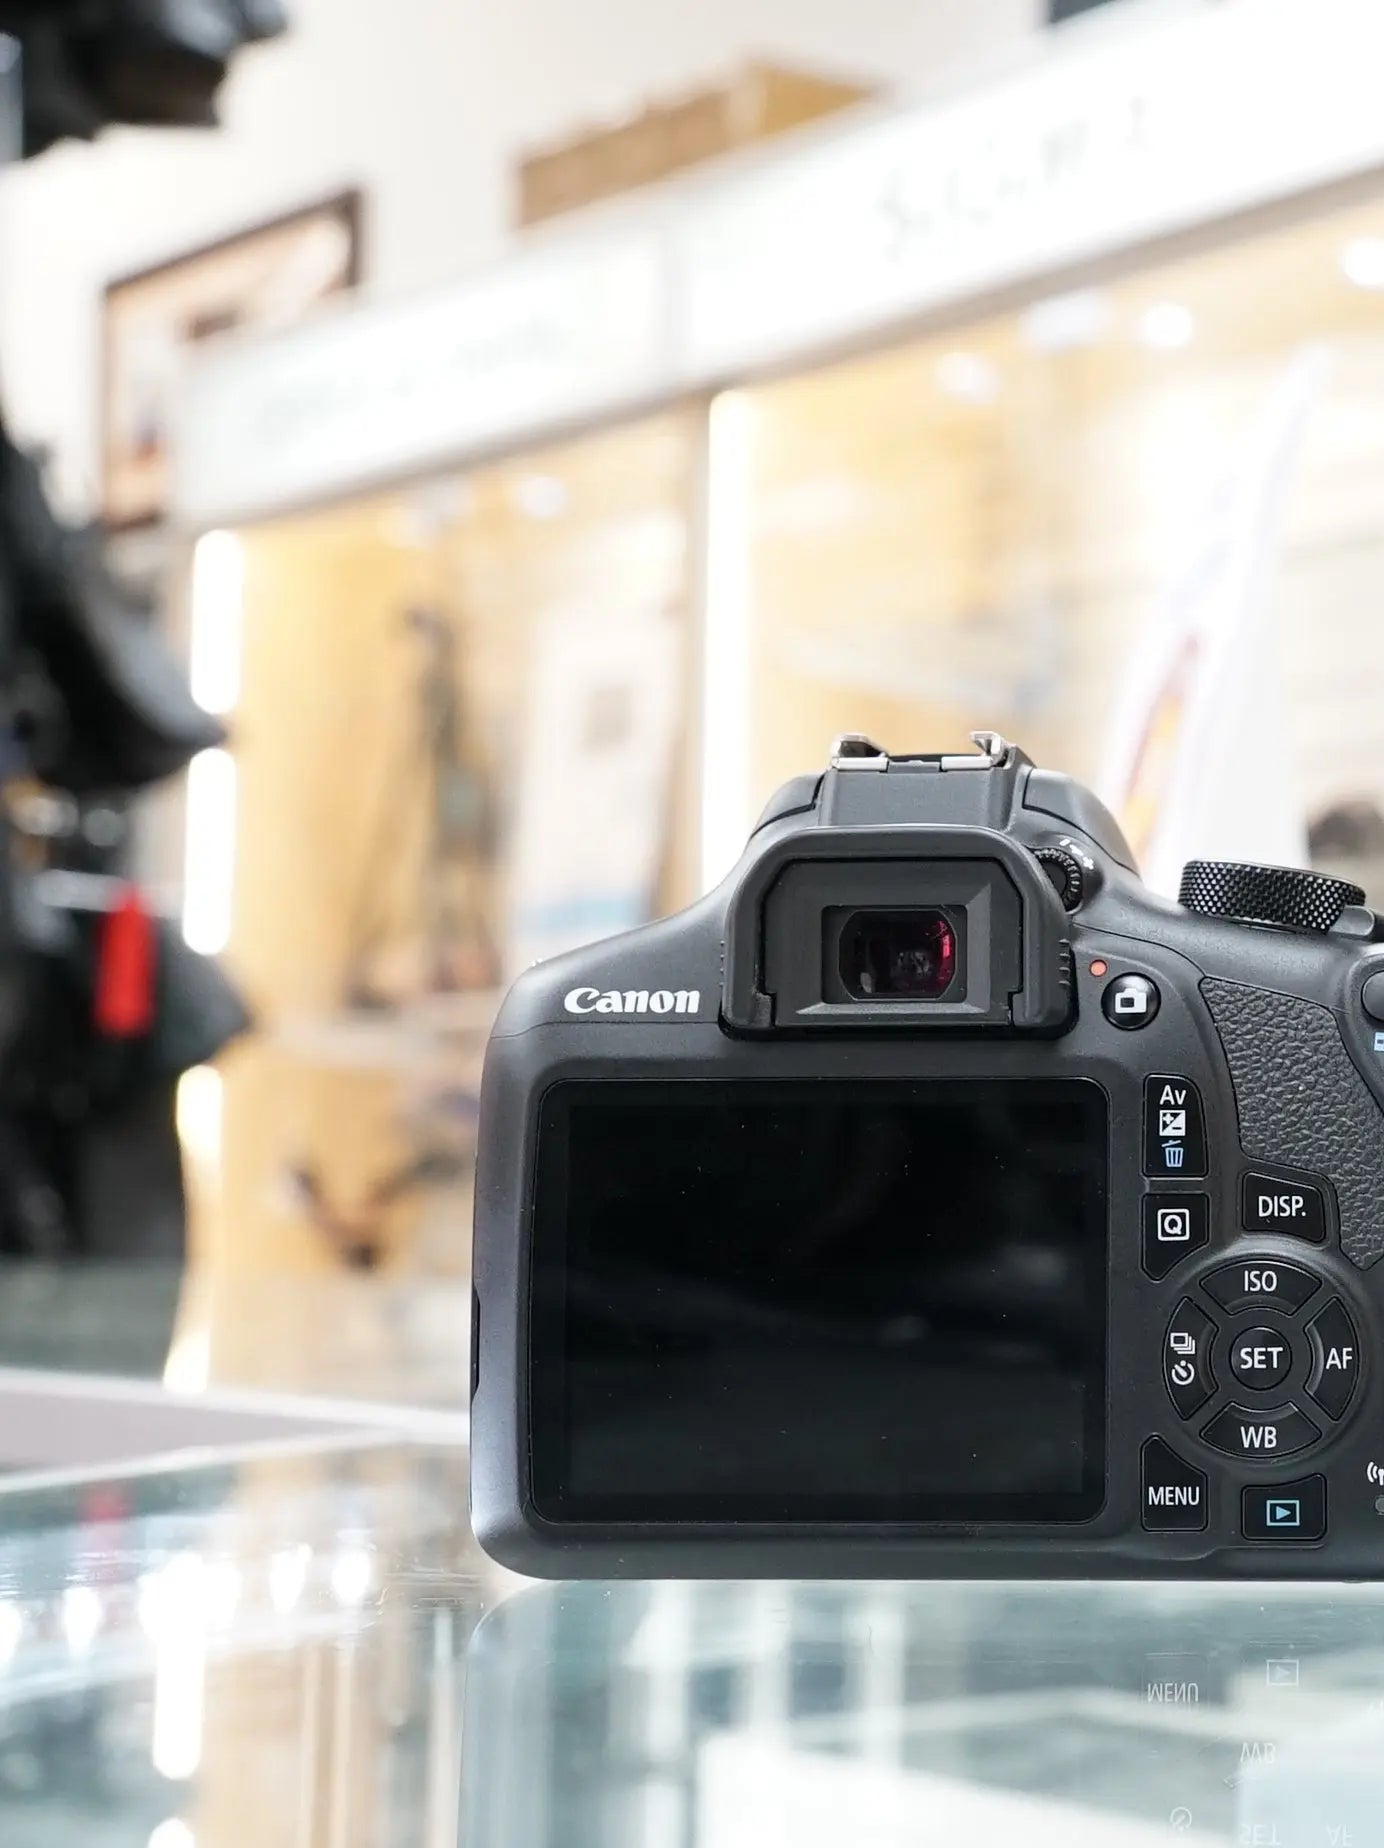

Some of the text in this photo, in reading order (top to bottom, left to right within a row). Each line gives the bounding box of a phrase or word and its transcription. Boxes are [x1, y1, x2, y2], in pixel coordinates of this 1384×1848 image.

[564, 987, 700, 1014] Canon
[1160, 1084, 1186, 1105] Av
[1258, 1196, 1306, 1218] DISP.
[1163, 1215, 1181, 1235] Q
[1244, 1271, 1278, 1292] ISO
[1240, 1347, 1283, 1369] SET
[1326, 1348, 1352, 1369] AF
[1240, 1426, 1277, 1448] WB
[1148, 1486, 1200, 1506] MENU
